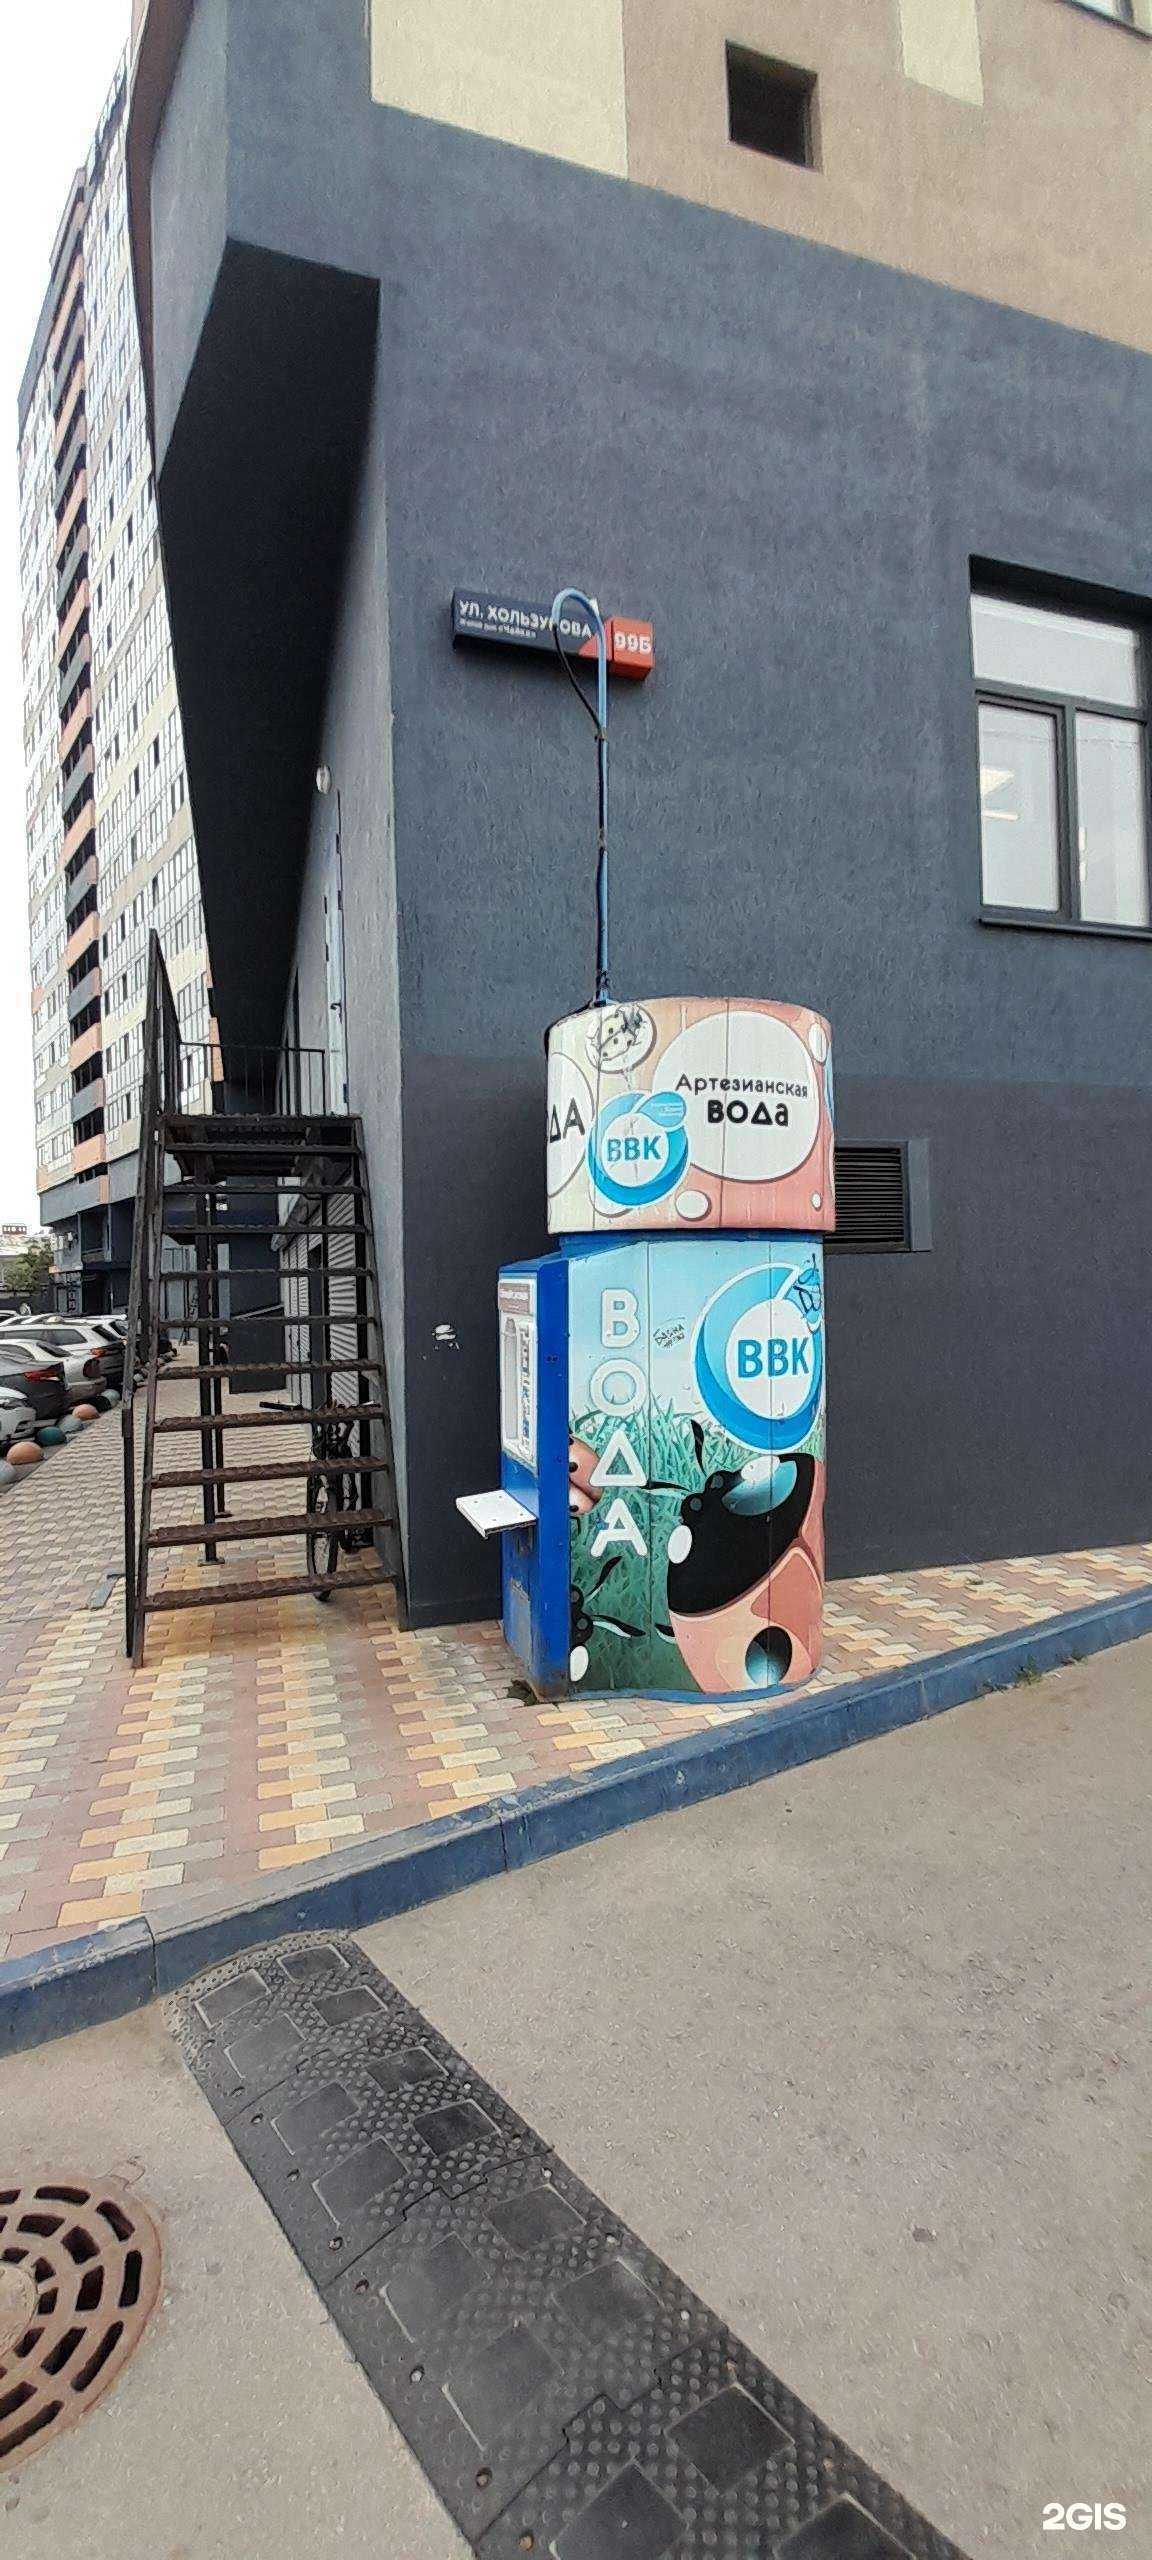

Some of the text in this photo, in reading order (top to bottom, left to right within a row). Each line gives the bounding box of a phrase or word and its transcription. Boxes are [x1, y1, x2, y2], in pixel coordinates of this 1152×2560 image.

[459, 600, 483, 618] УЛ.
[614, 631, 652, 654] 99Б
[675, 1073, 808, 1098] Артезианская
[607, 1135, 662, 1162] ВВК
[738, 1337, 810, 1378] ВВК
[589, 1287, 648, 1557] ВОДА
